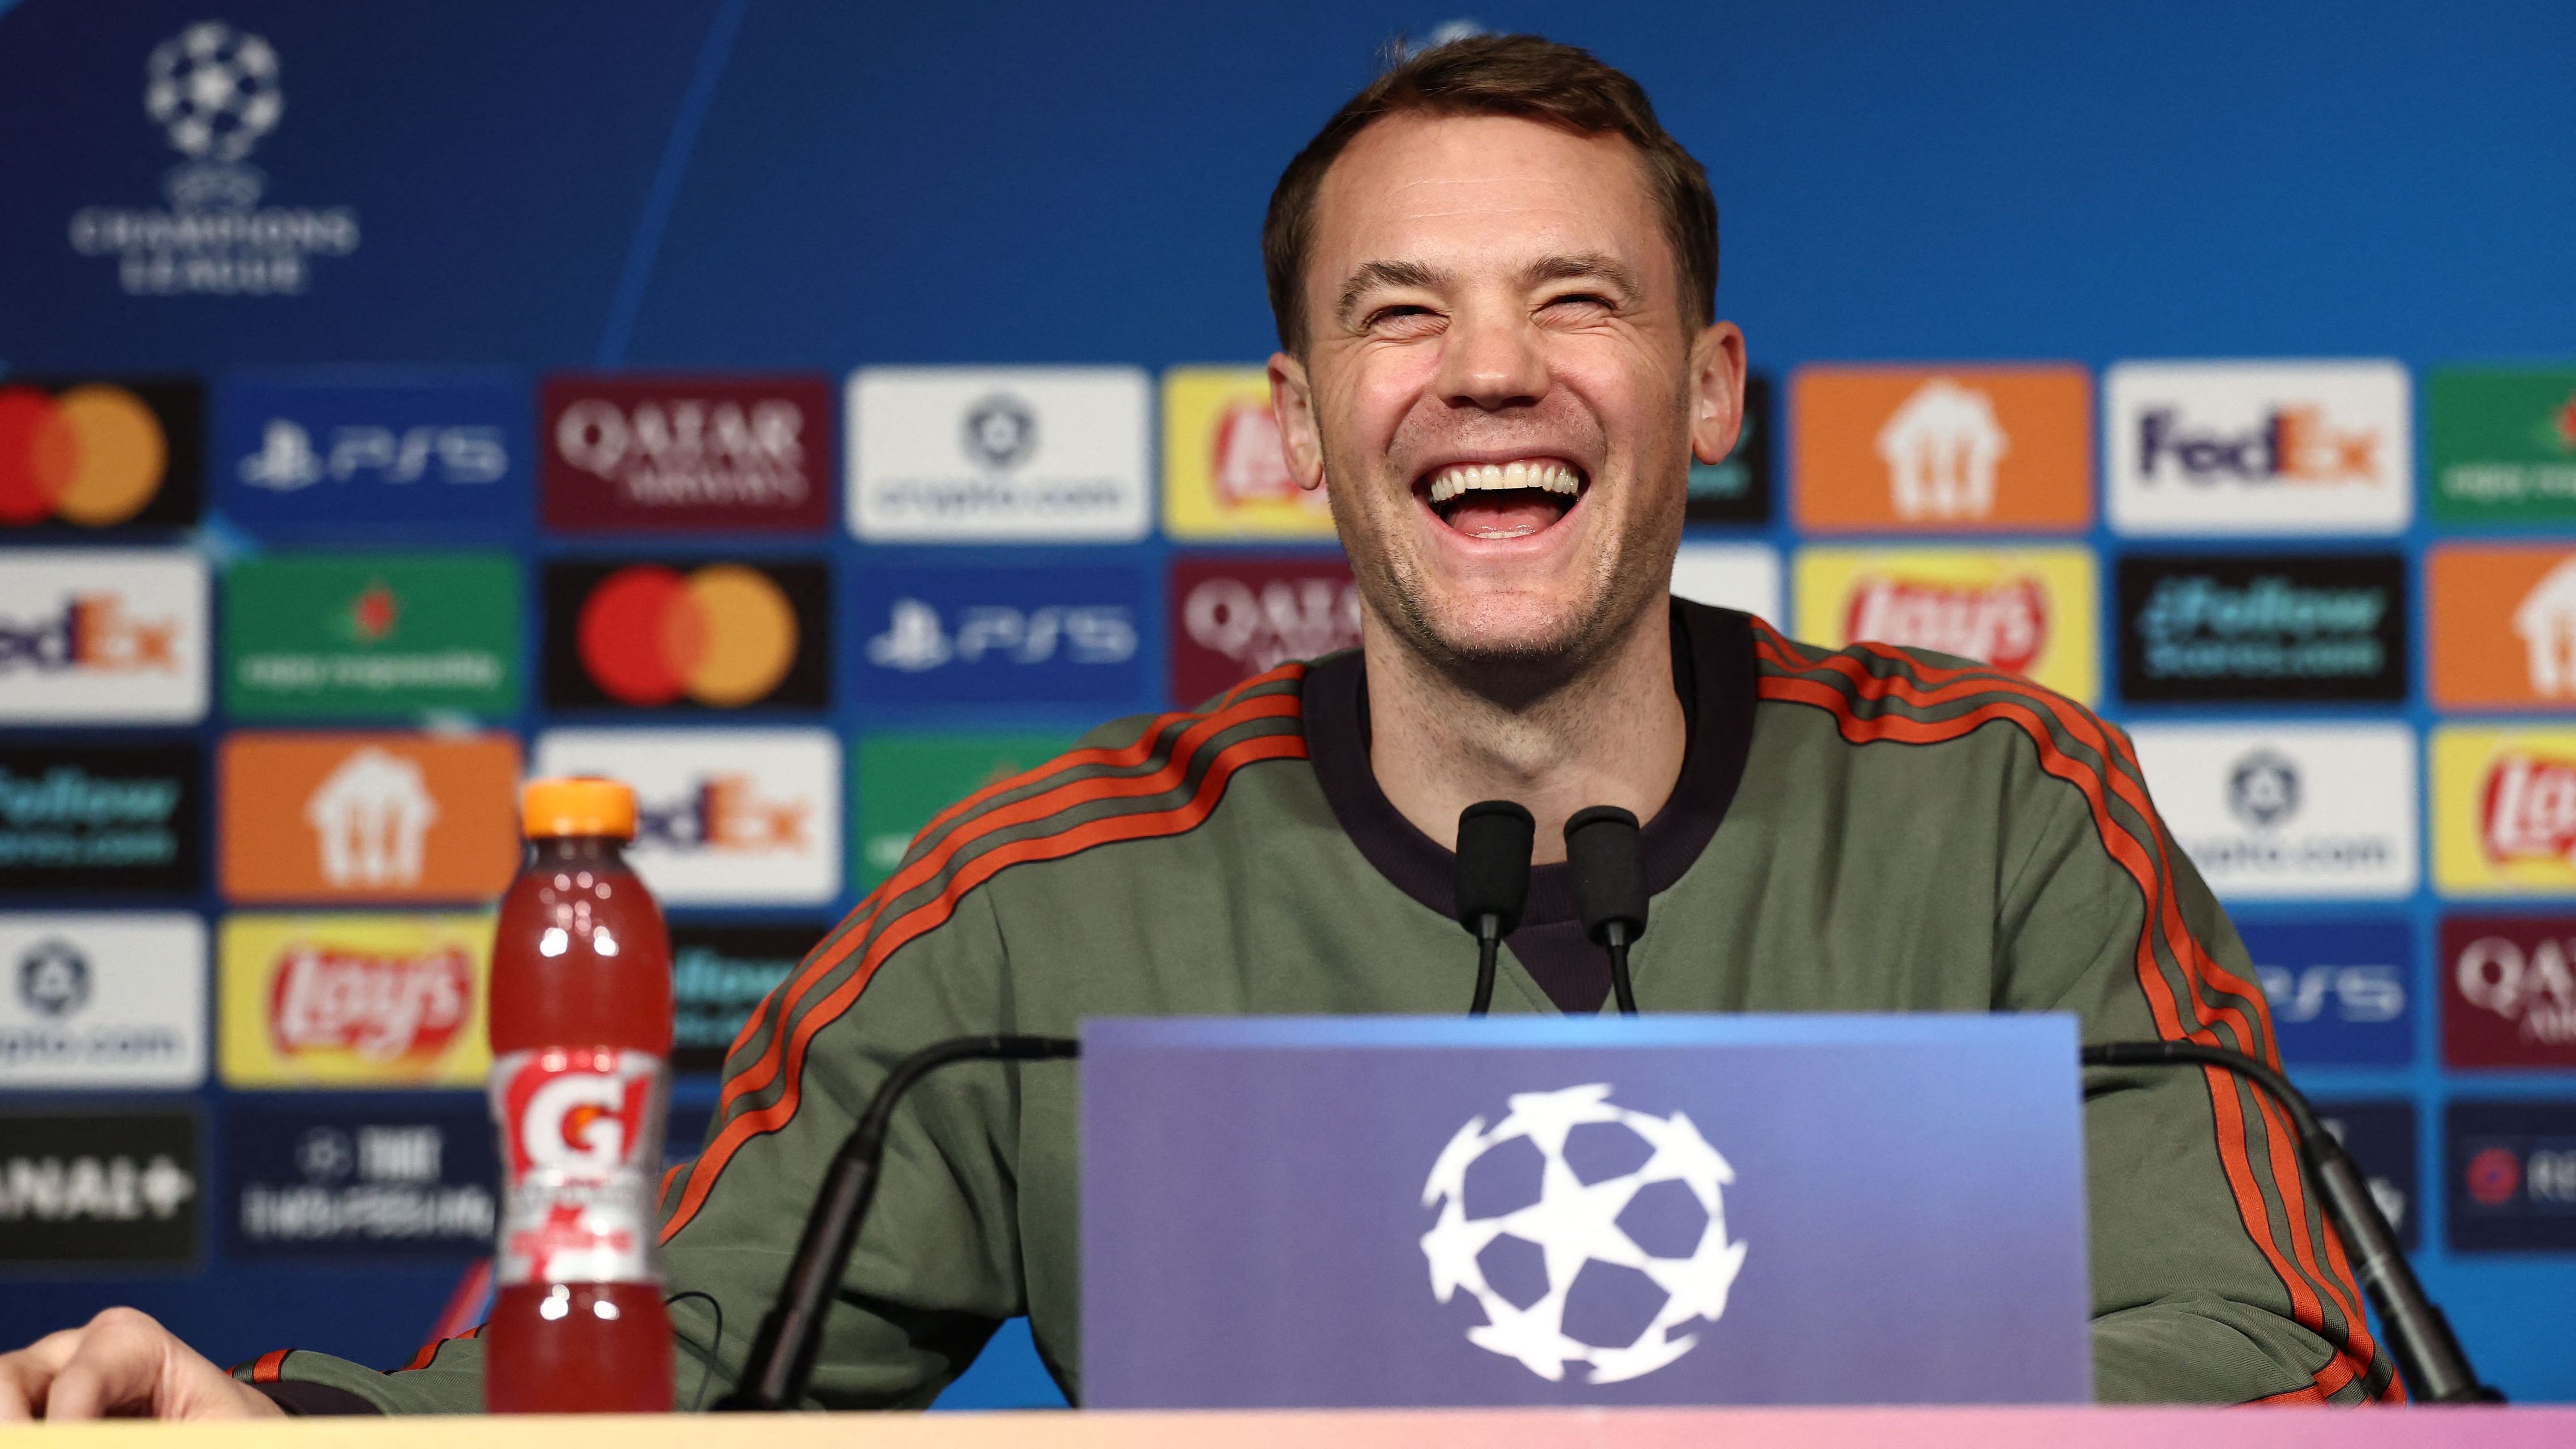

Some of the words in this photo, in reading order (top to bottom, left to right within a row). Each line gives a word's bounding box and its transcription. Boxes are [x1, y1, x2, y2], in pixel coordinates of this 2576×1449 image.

[69, 205, 361, 256] CHAMPIONS
[119, 251, 307, 296] LEAGUE
[328, 426, 506, 483] PS5
[555, 398, 804, 481] QATAR
[2137, 405, 2382, 487] FedEx
[878, 477, 1122, 517] crypto.com
[0, 592, 176, 670] edEx
[957, 606, 1137, 664] PS5
[279, 950, 465, 1058] Lay's
[520, 1077, 623, 1170] G
